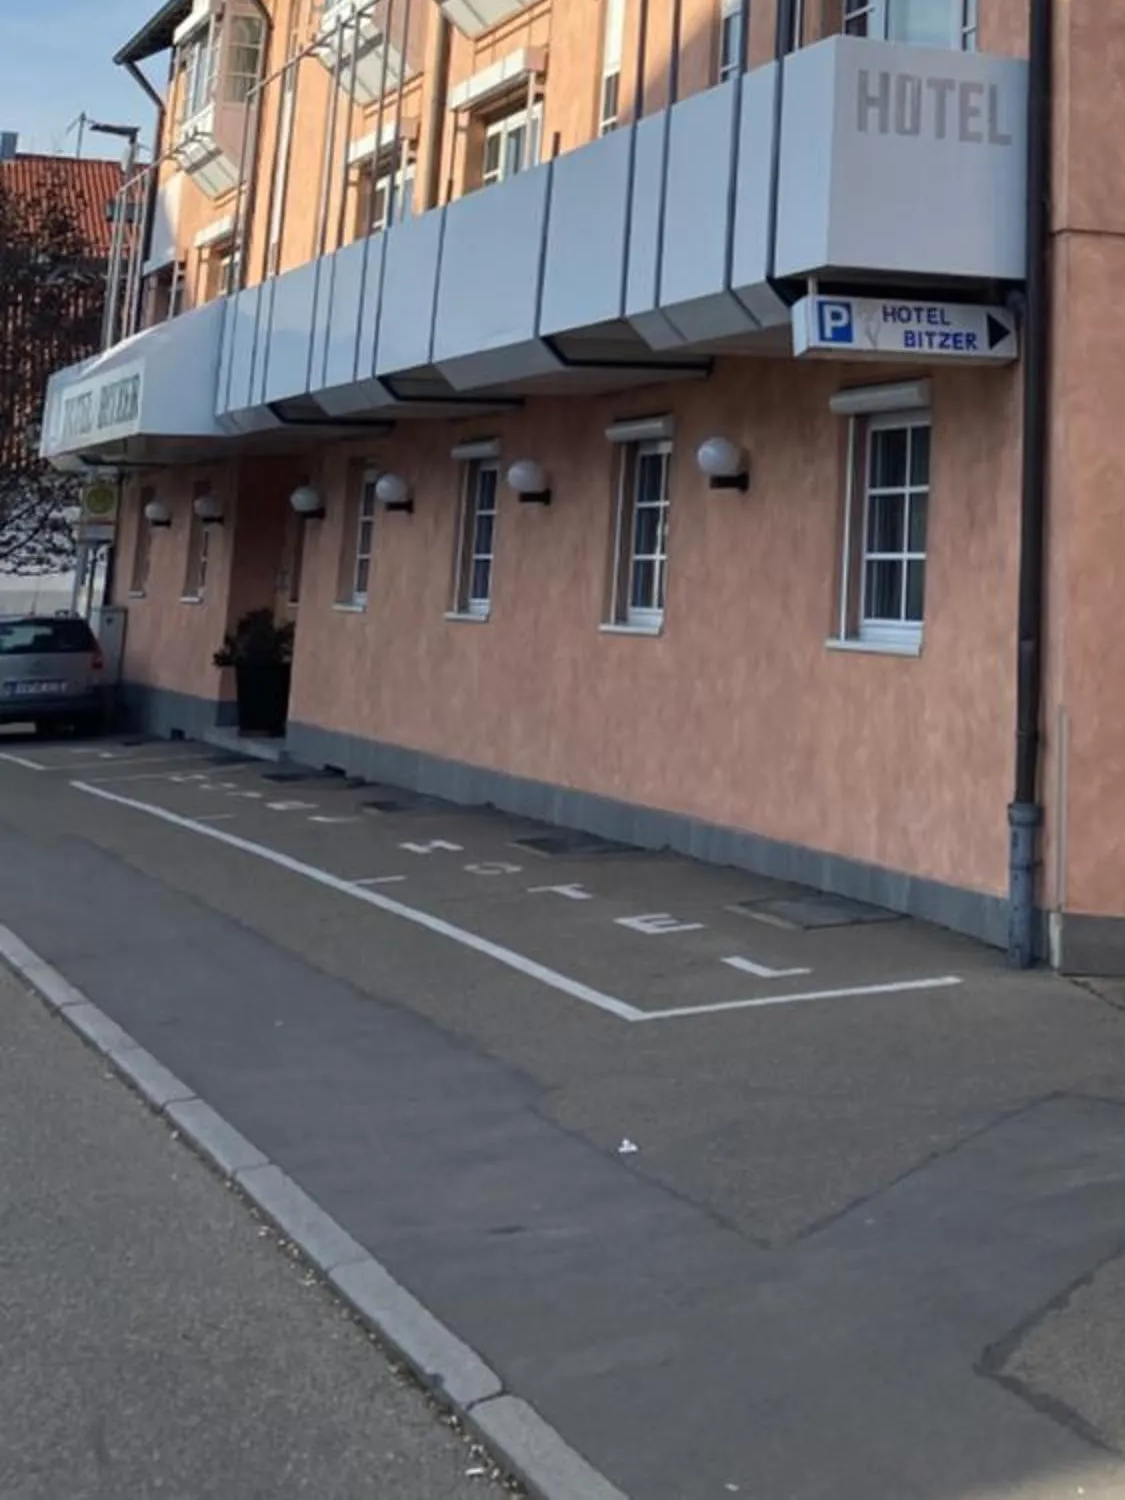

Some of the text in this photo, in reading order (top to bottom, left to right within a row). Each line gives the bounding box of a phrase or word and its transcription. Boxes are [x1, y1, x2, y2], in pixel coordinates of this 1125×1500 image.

[856, 69, 1013, 146] HOTEL
[822, 304, 848, 339] P
[882, 304, 952, 326] HOTEL
[903, 330, 978, 350] BITZER
[400, 839, 812, 978] HOTEL
